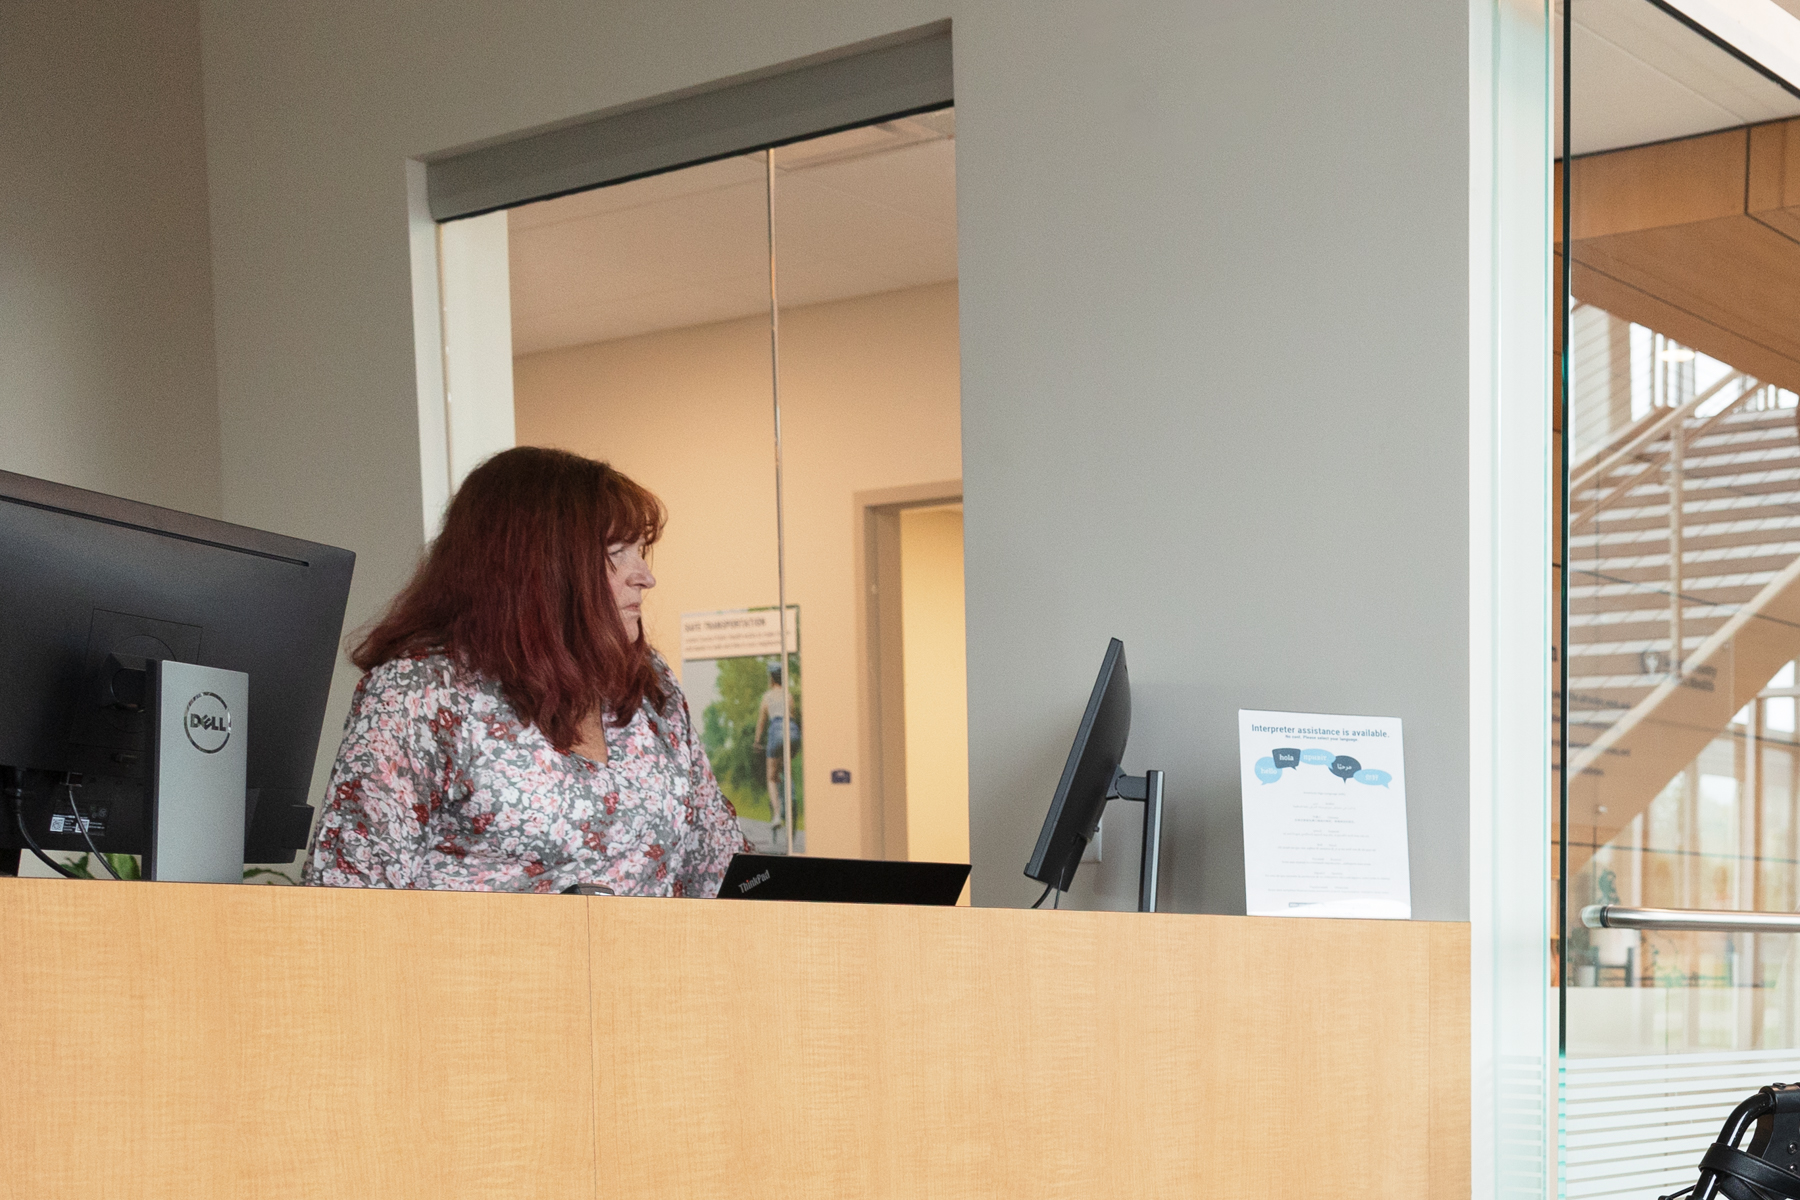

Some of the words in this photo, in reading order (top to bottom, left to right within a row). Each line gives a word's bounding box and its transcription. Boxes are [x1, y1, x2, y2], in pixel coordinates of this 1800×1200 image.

[190, 713, 227, 732] DELL
[1251, 724, 1295, 733] Interpreter
[1297, 727, 1341, 736] assistance
[1342, 728, 1350, 736] is
[1351, 729, 1390, 738] available.
[738, 869, 770, 893] ThinkPad
